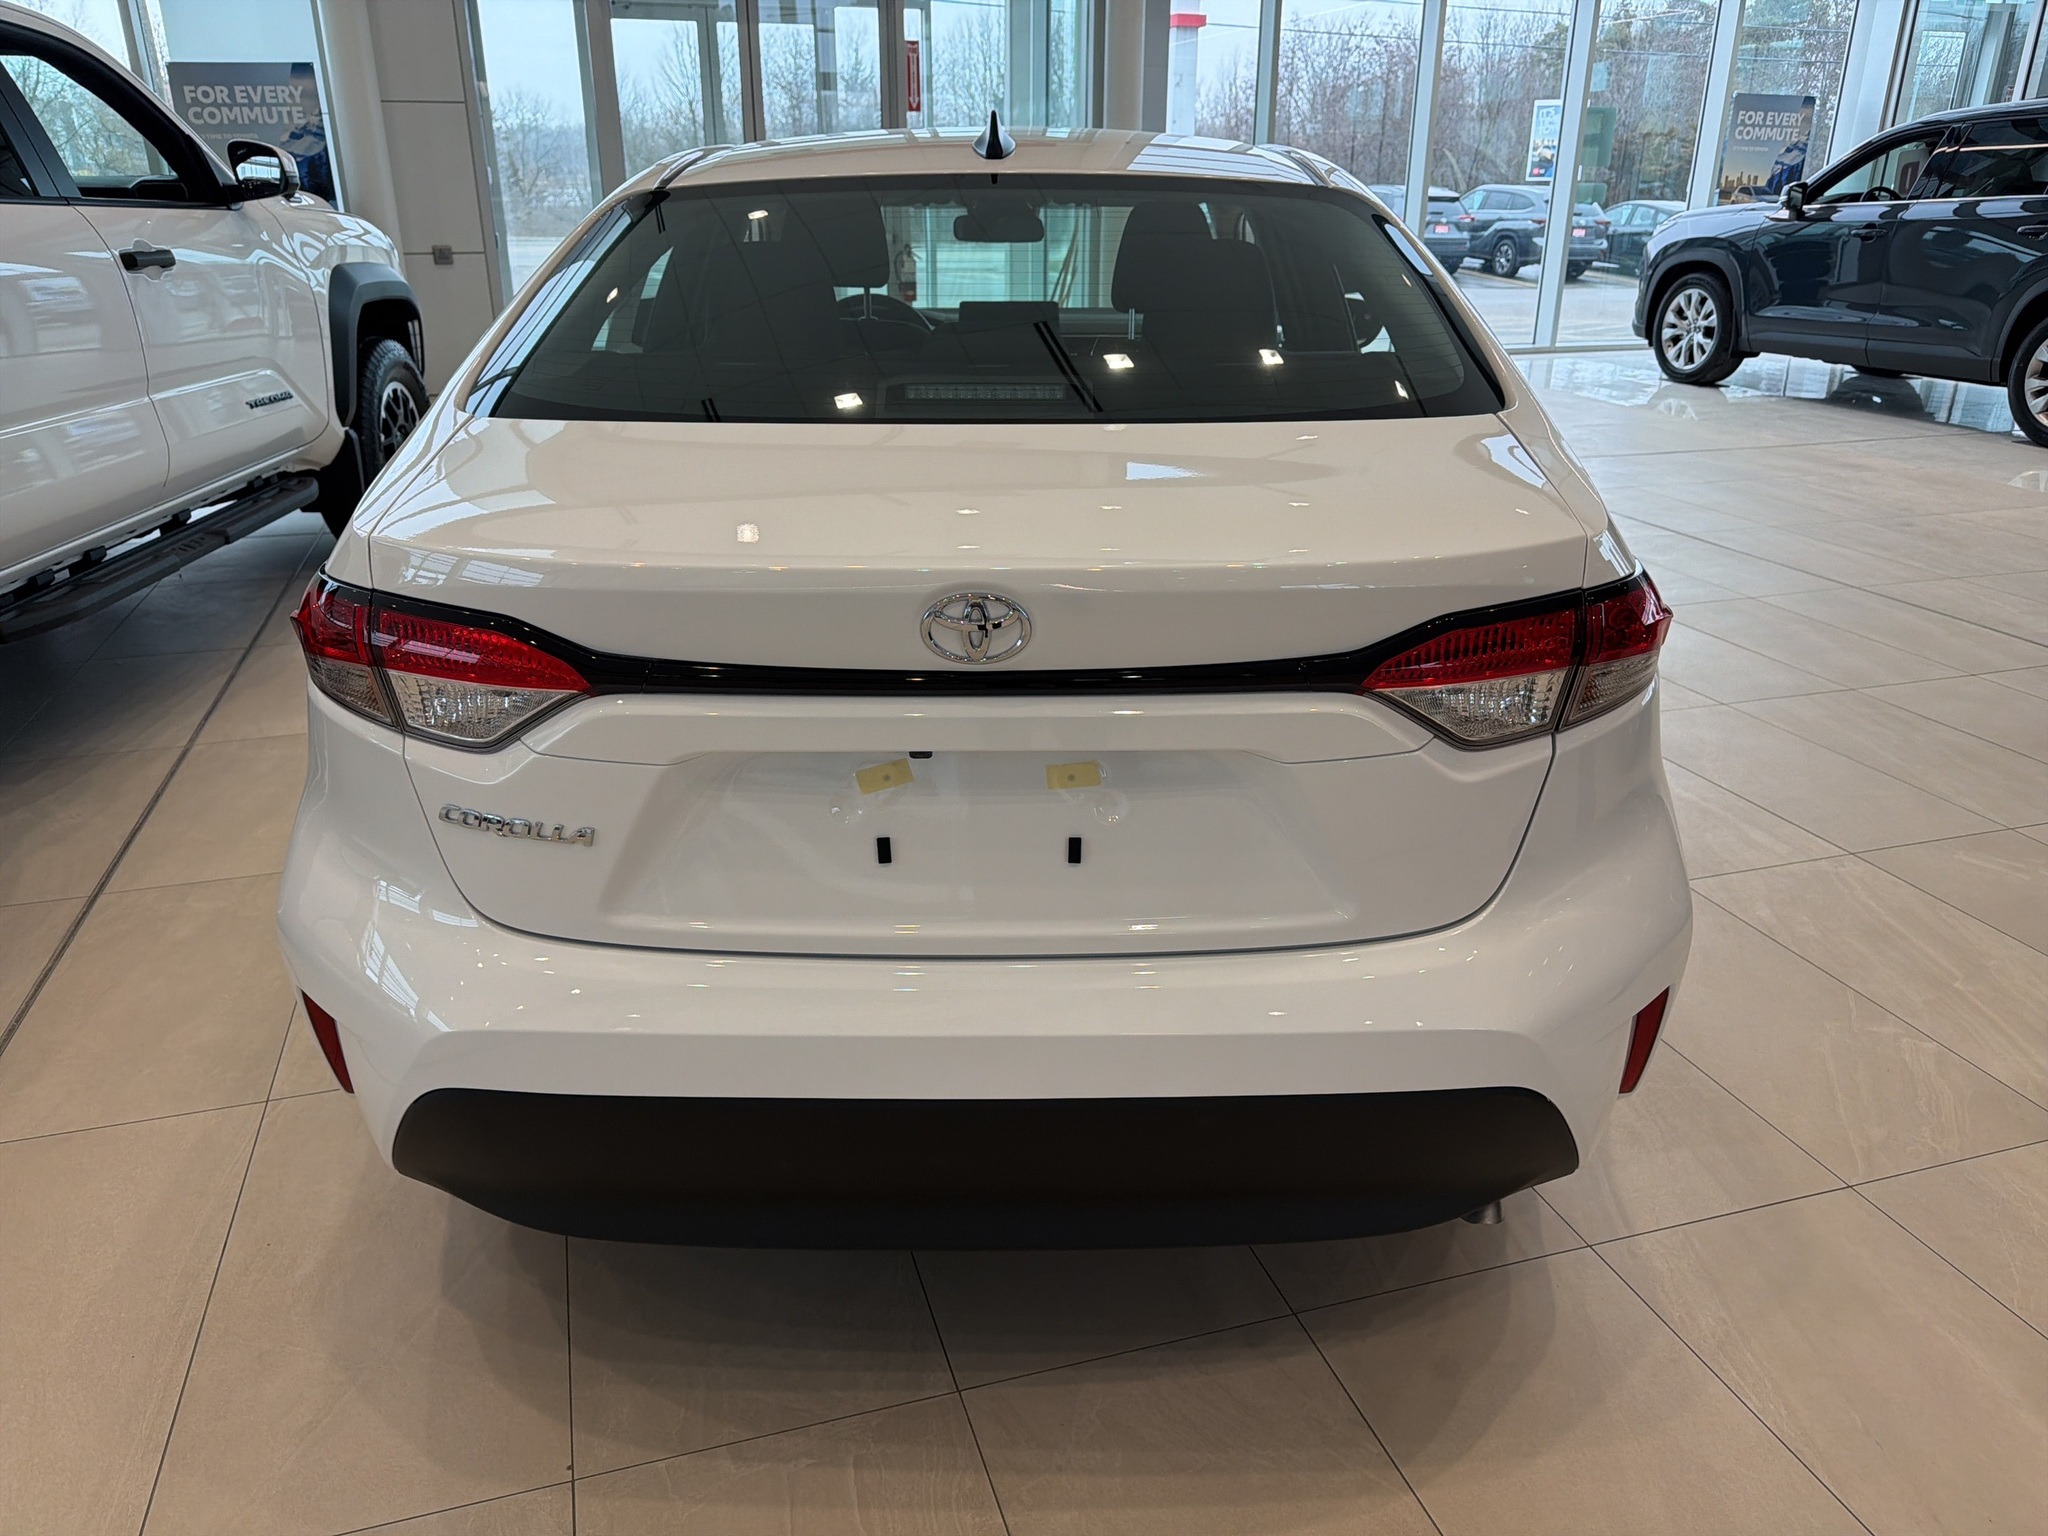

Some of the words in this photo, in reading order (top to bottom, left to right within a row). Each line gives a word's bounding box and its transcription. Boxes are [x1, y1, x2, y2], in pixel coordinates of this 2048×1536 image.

[183, 85, 231, 104] FOR
[233, 85, 303, 104] EVERY
[187, 106, 305, 125] COMMUTE
[1737, 110, 1765, 126] FOR
[1766, 111, 1805, 127] EVERY
[1734, 126, 1800, 141] COMMUTE
[438, 803, 595, 847] COROLLA
